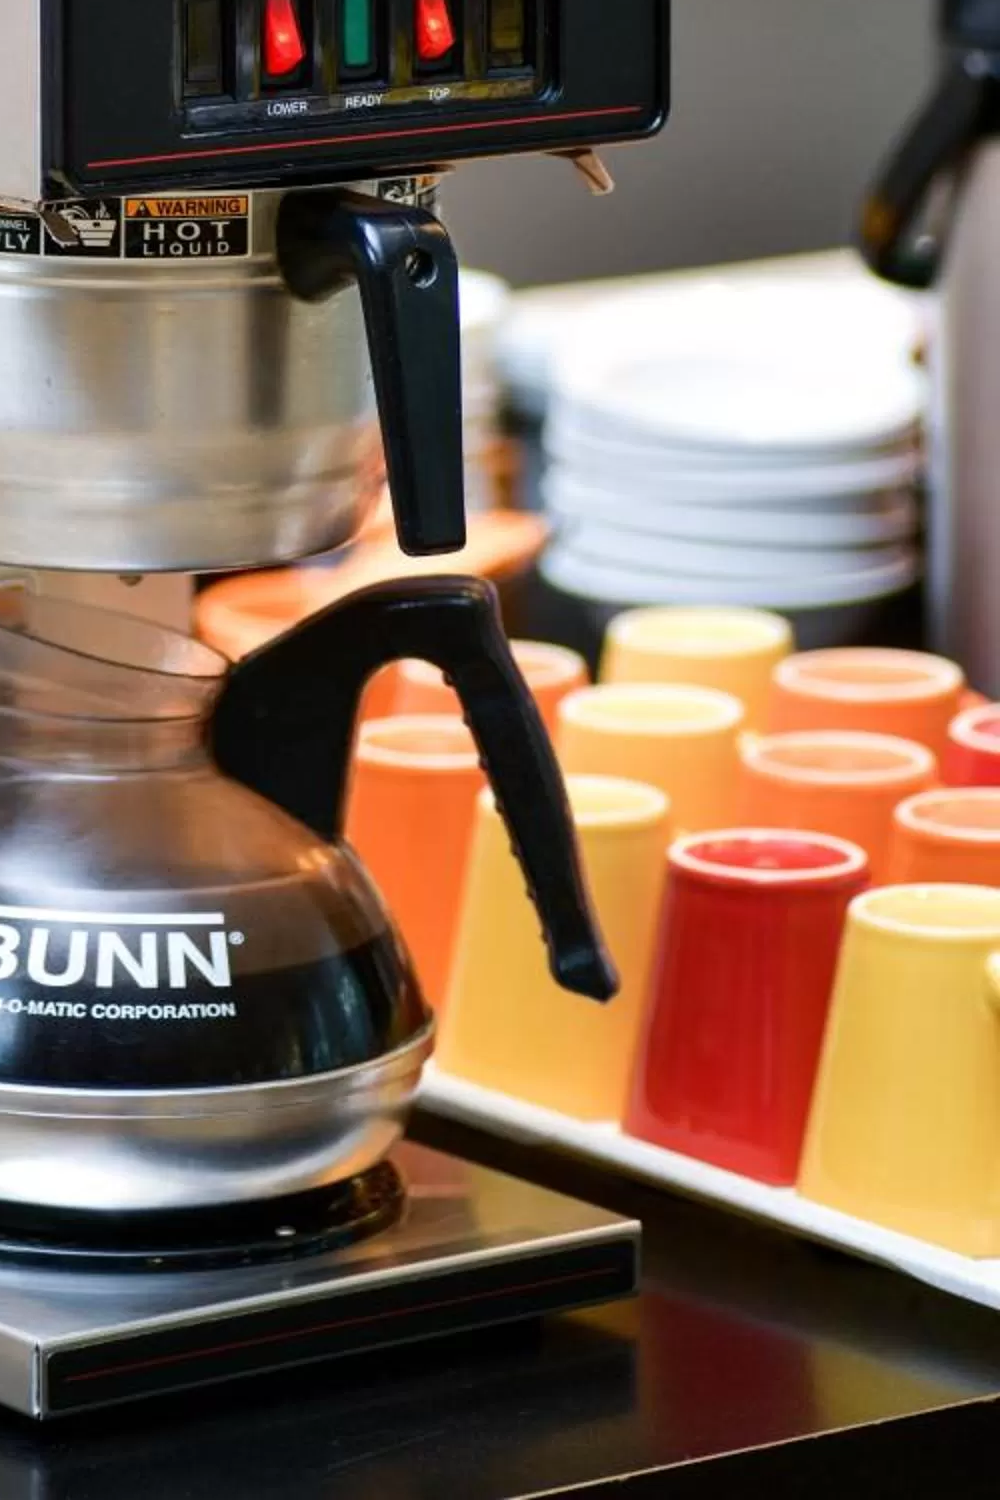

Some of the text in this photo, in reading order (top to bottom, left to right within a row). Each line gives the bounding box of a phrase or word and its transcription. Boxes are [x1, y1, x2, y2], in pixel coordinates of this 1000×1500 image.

[345, 94, 384, 109] READY
[428, 87, 451, 100] TOP
[267, 101, 308, 117] LOWER
[157, 199, 241, 215] WARNING
[143, 221, 231, 241] HOT
[143, 241, 230, 256] LIQUID
[91, 1002, 237, 1020] CORPORATION
